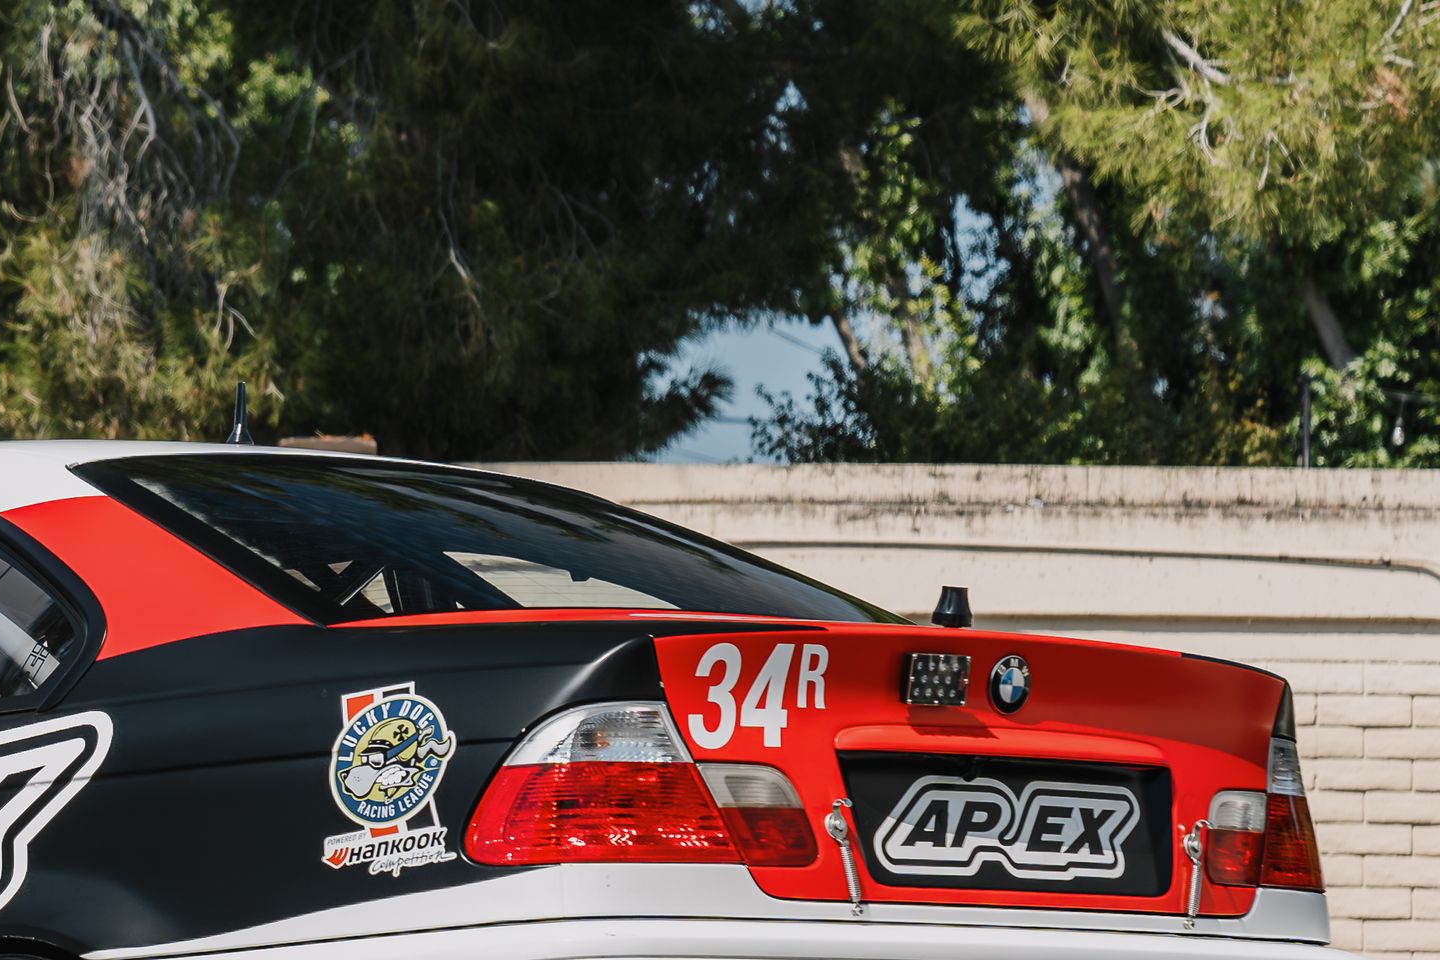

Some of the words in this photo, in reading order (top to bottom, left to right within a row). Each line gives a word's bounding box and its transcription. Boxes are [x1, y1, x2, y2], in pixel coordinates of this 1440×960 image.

[997, 658, 1029, 677] BMW
[338, 701, 392, 763] LUCKY
[398, 699, 435, 730] DOG
[356, 801, 396, 819] RACING
[399, 772, 434, 813] LEAGUE
[326, 834, 357, 846] POWERED
[358, 832, 367, 842] BY
[370, 850, 451, 873] Competition
